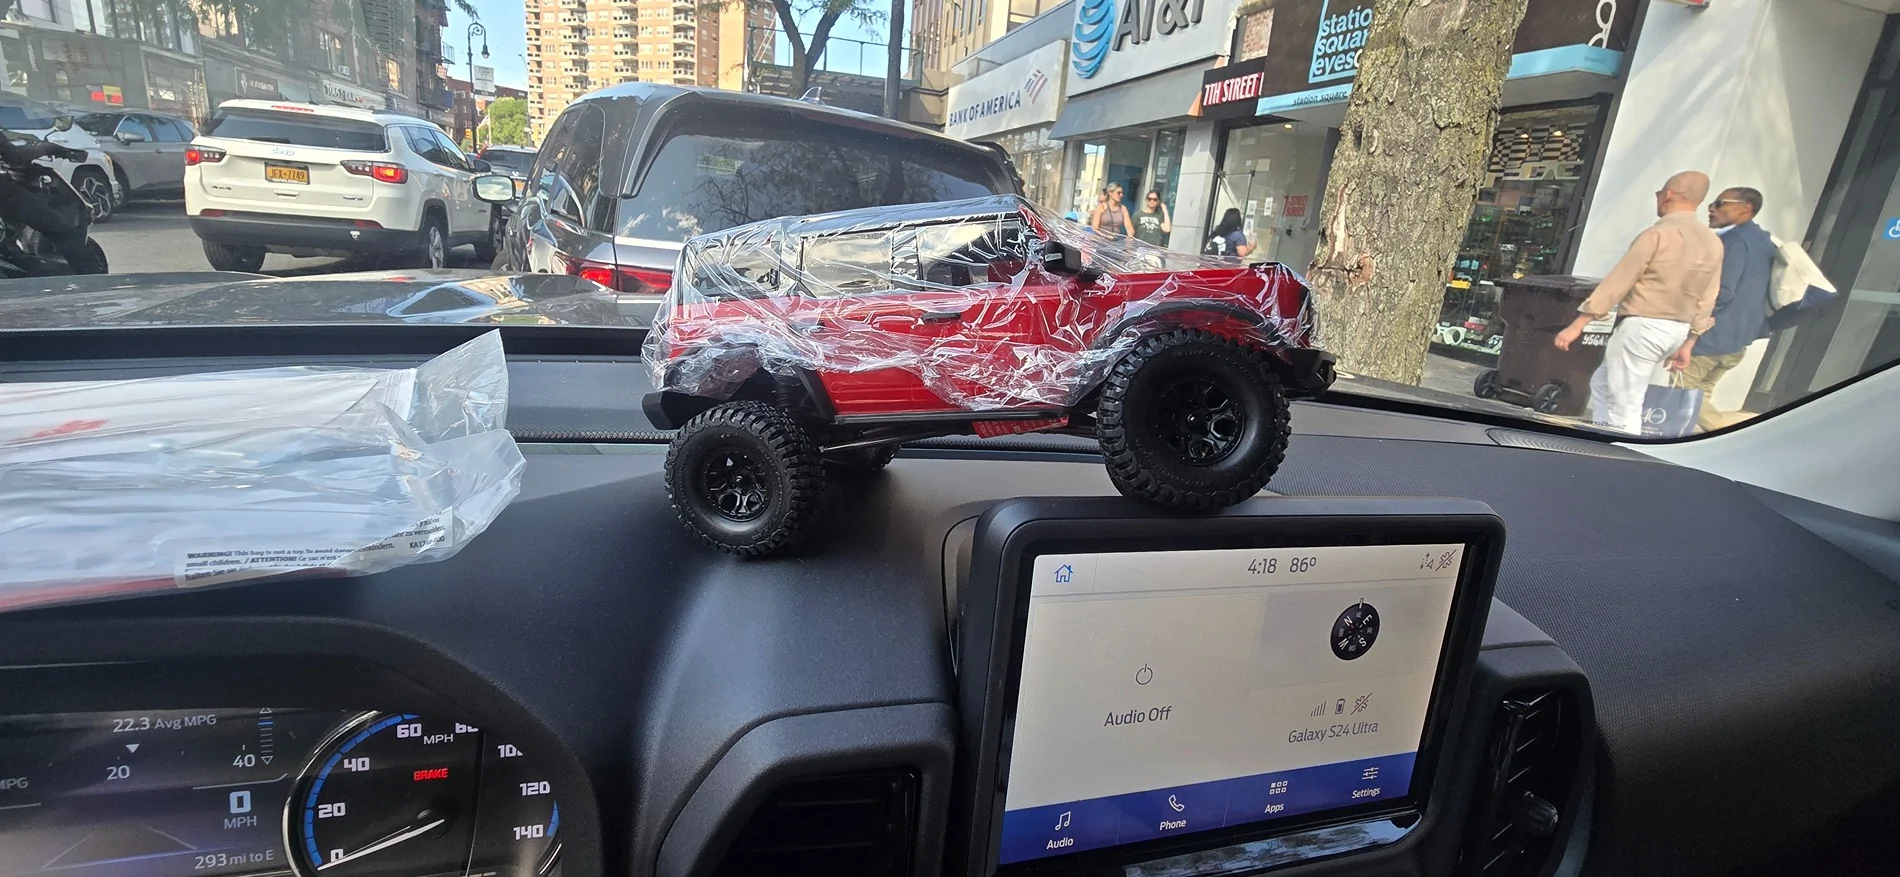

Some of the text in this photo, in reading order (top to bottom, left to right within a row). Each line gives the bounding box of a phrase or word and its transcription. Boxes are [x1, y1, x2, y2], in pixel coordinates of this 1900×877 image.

[1321, 5, 1373, 37] statio
[1316, 29, 1369, 56] squar
[1203, 80, 1222, 106] 7TH
[1222, 73, 1260, 103] STREET
[1292, 90, 1348, 106] station square
[949, 90, 1020, 127] BANK OF AMERICA
[187, 551, 232, 559] WARNING!
[1248, 558, 1277, 574] 4:18
[1344, 615, 1353, 626] N
[1362, 614, 1372, 625] E
[1337, 638, 1349, 650] W
[1358, 637, 1367, 647] S
[112, 714, 217, 733] 22.3 Avg MPG
[1104, 705, 1172, 727] Audio Off
[396, 723, 422, 738] 60
[1288, 721, 1378, 743] Galaxy S24 Ultra
[423, 733, 454, 745] MPH
[497, 744, 524, 758] 10
[232, 754, 256, 768] 40
[343, 757, 370, 772] 40
[106, 765, 131, 780] 20
[413, 768, 449, 781] BRAKE
[519, 781, 551, 796] 120
[1351, 787, 1381, 799] Settings
[229, 790, 252, 814] 0
[1264, 803, 1285, 814] Apps
[318, 802, 346, 819] 20
[224, 815, 257, 829] MPH
[1159, 819, 1187, 831] Phone
[513, 824, 544, 840] 140
[1046, 837, 1074, 850] Audio
[194, 850, 275, 870] 293 mi to E
